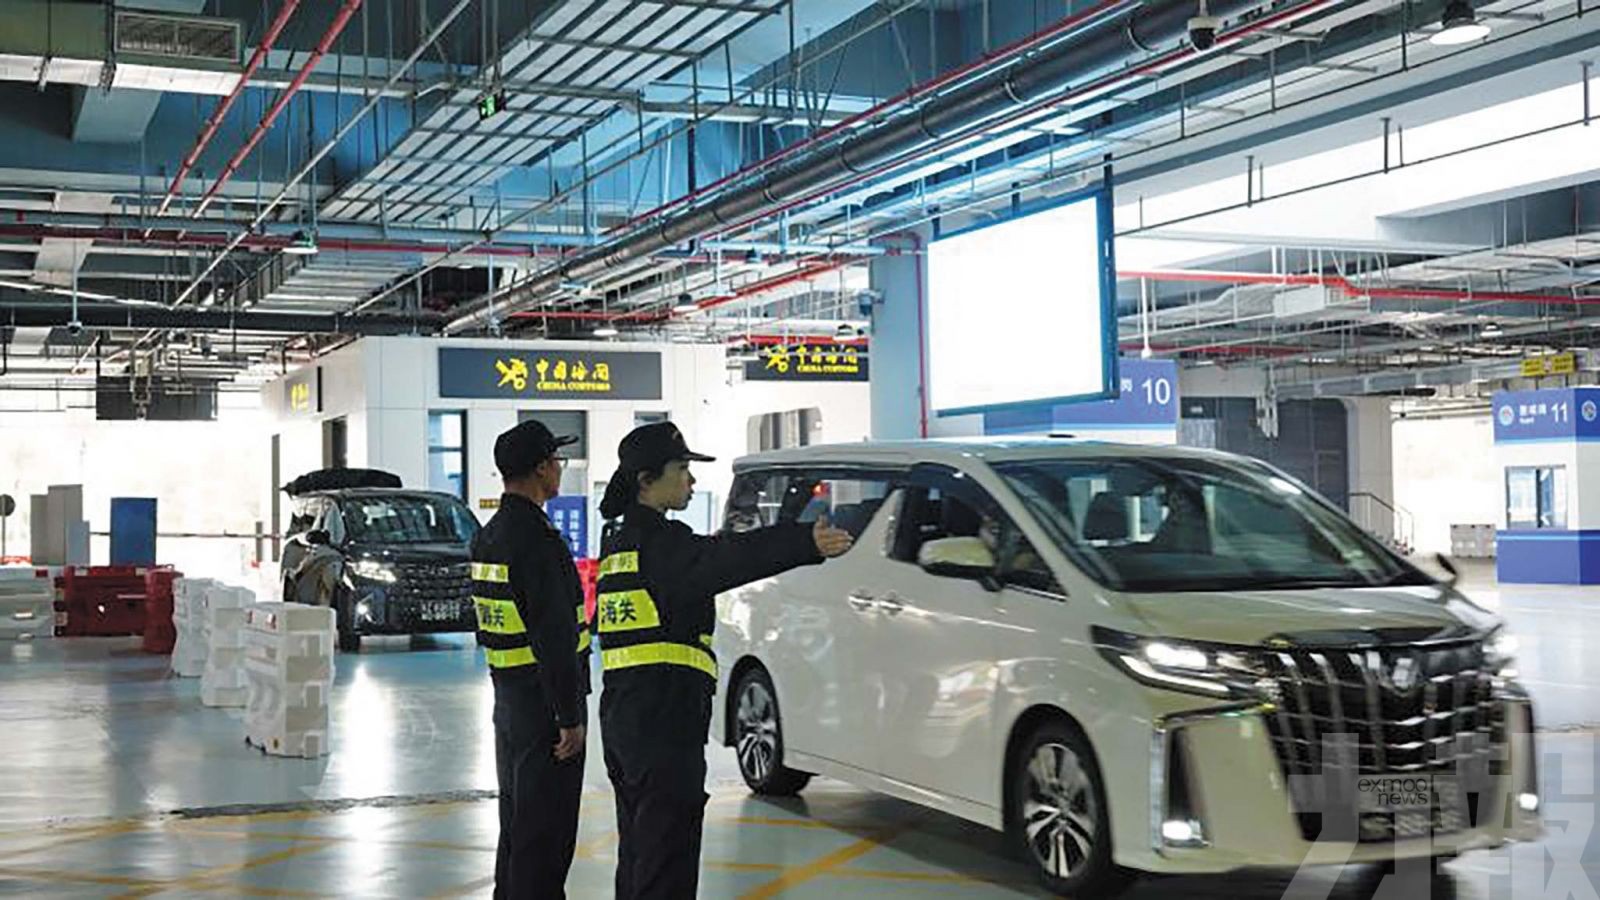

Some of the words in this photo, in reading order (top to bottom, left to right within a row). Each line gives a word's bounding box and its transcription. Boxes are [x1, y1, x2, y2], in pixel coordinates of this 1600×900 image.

[1141, 378, 1171, 405] 10
[1551, 402, 1568, 423] 11
[600, 599, 636, 625] 海关
